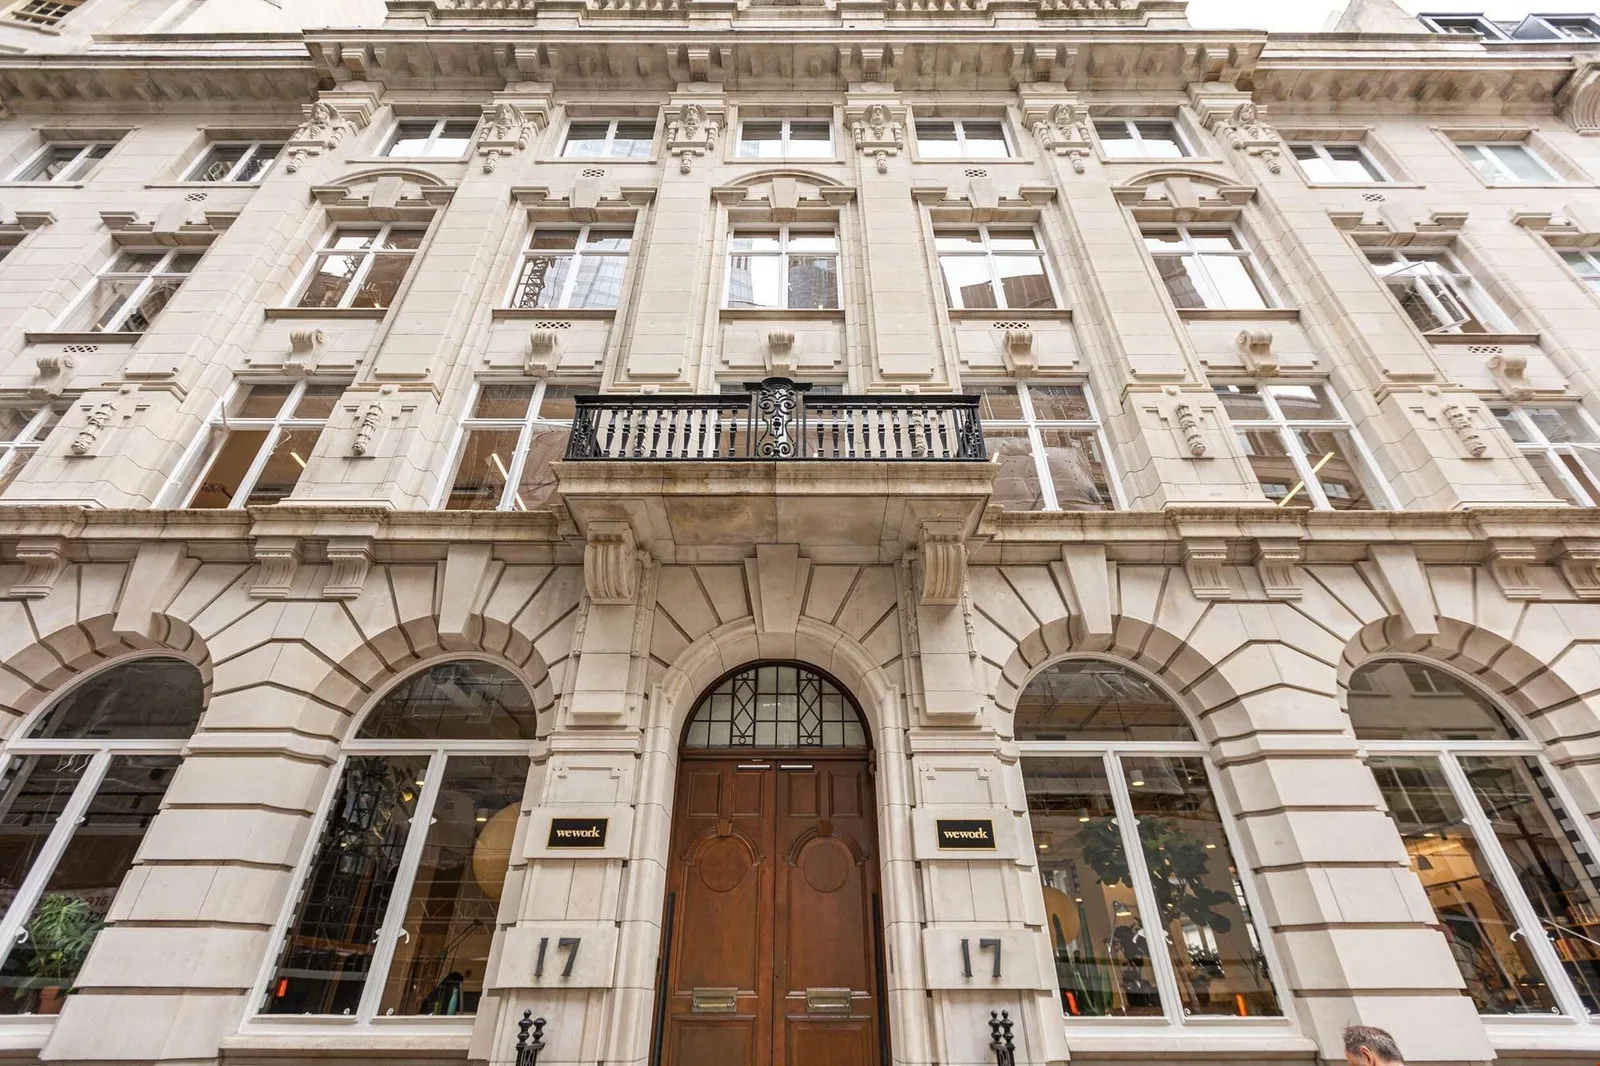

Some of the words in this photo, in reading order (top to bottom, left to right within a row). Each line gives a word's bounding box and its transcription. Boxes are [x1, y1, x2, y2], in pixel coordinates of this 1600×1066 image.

[556, 826, 601, 838] wework
[943, 827, 988, 839] wework
[533, 937, 581, 976] 17
[960, 938, 1002, 977] 17
